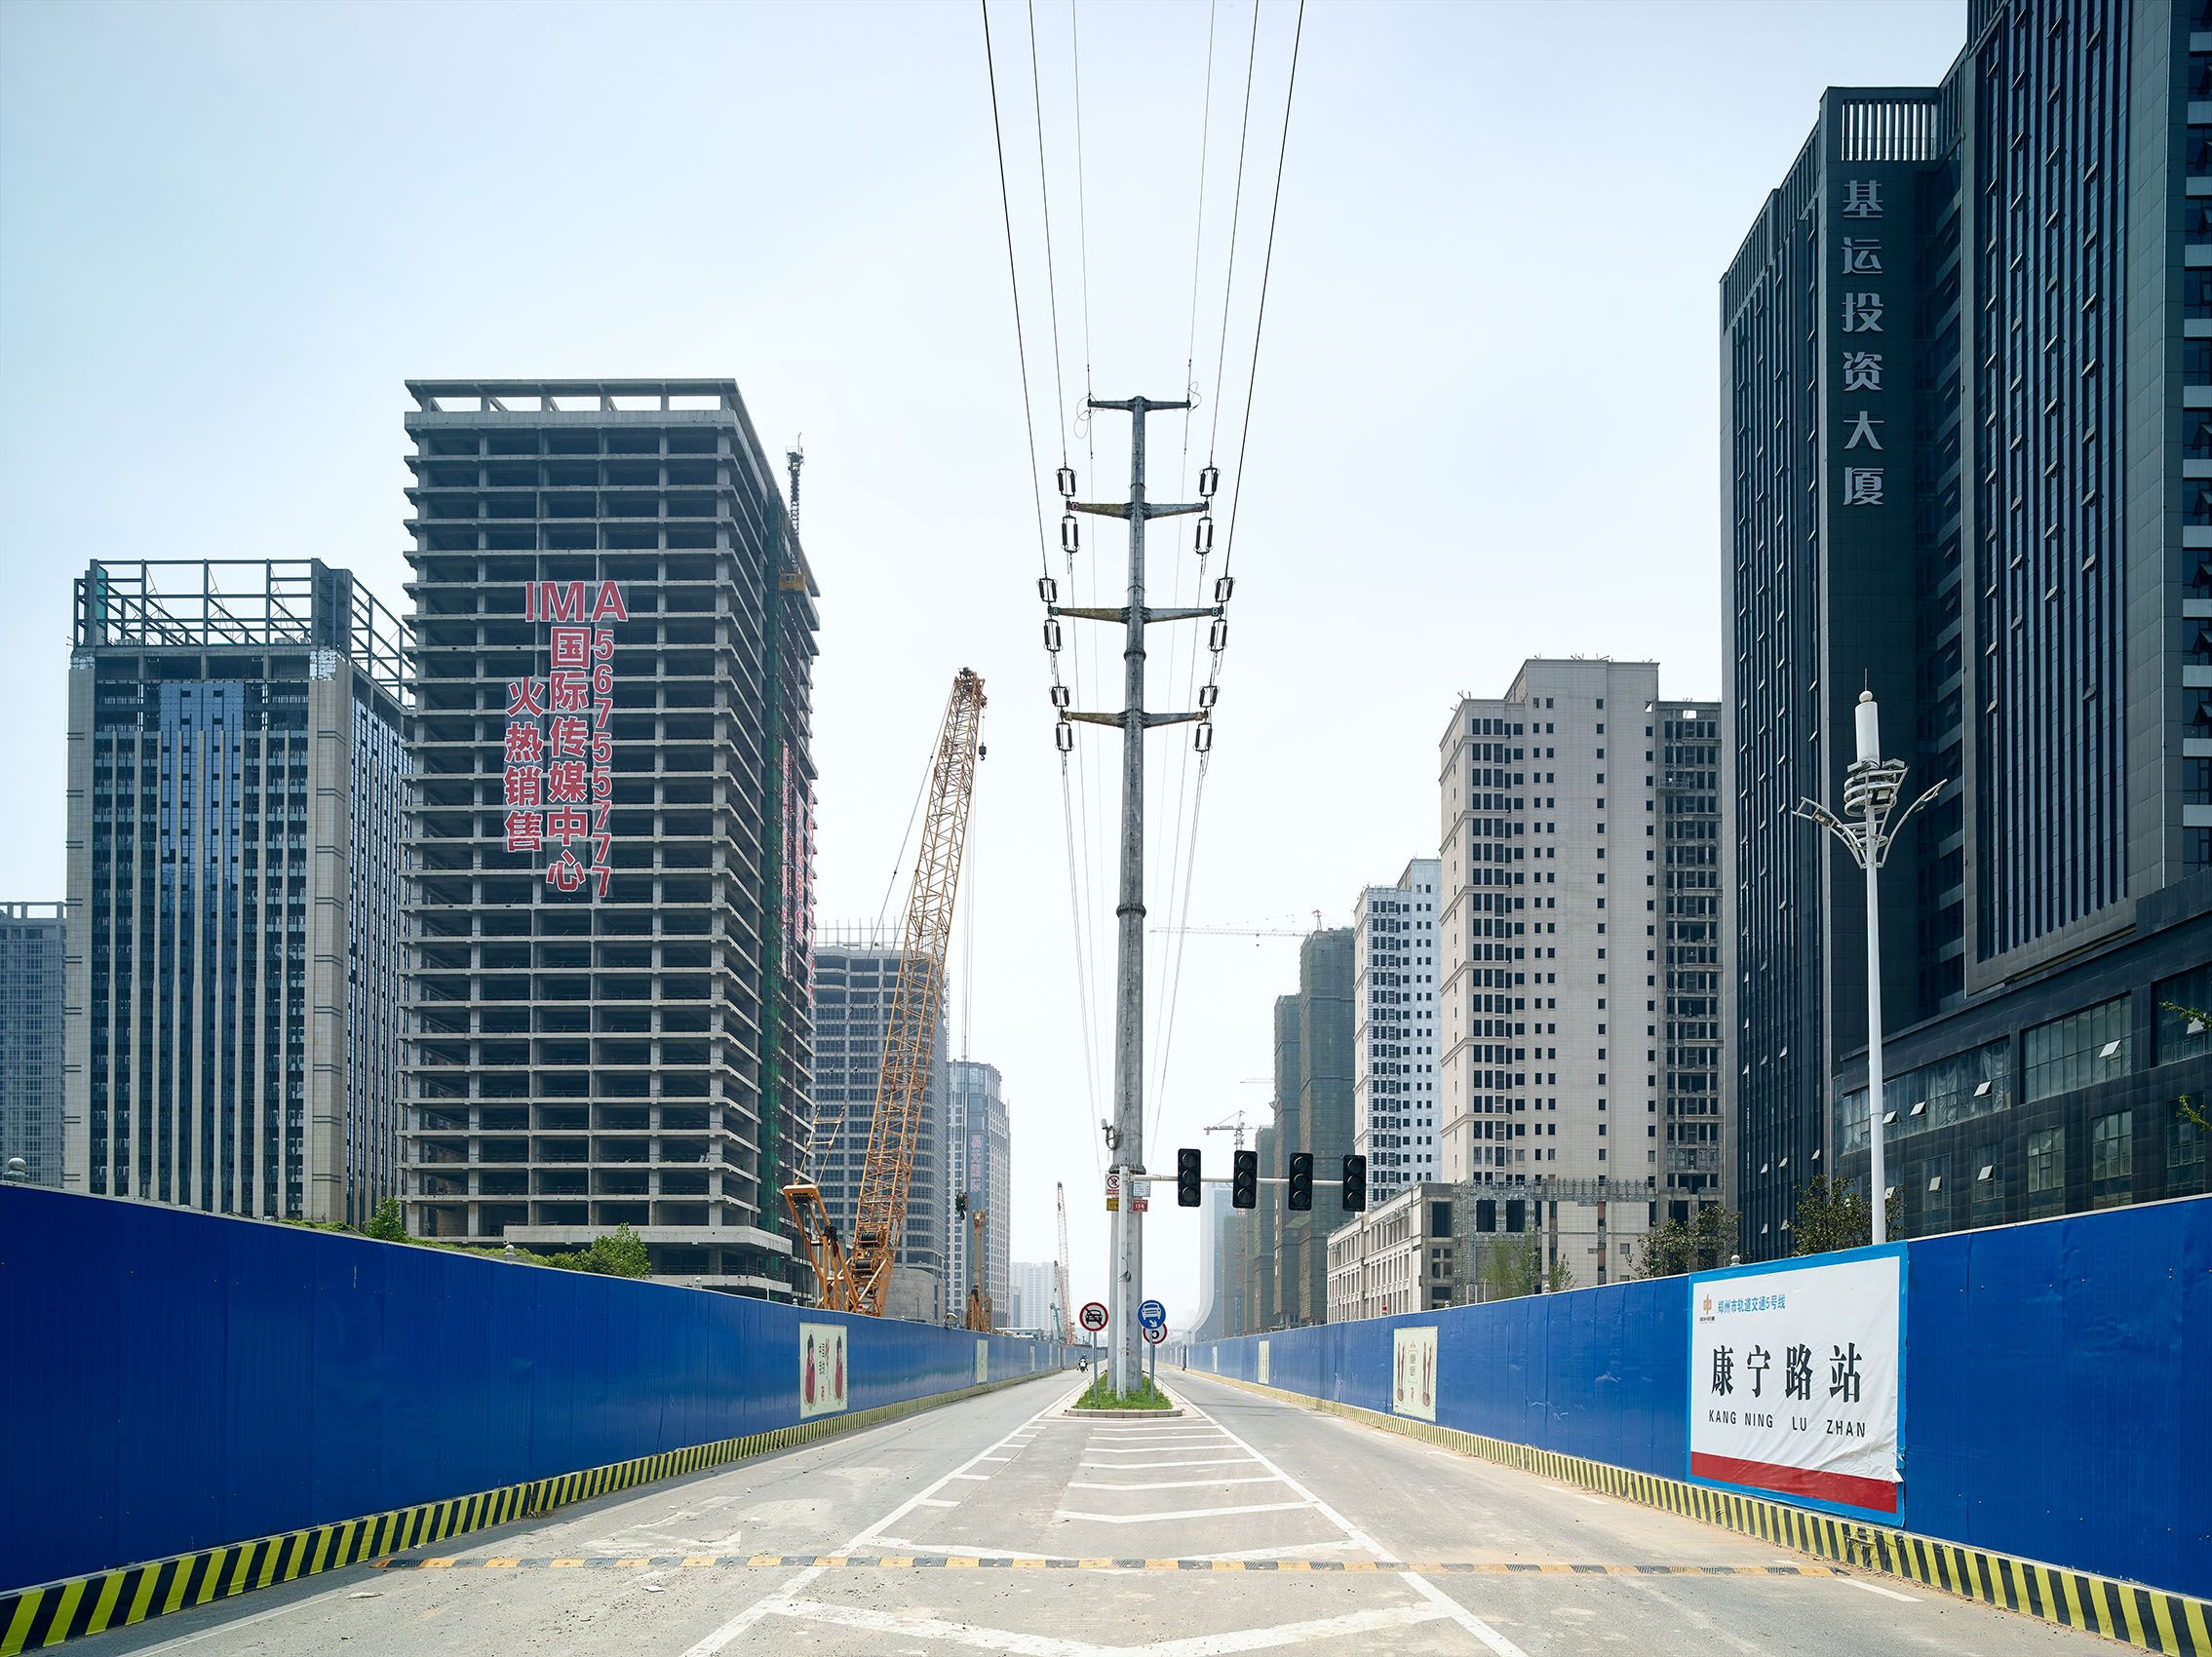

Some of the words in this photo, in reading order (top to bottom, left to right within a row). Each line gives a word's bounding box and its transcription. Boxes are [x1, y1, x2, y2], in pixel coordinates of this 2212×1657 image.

[1841, 179, 1884, 506] 基运投资大厦
[524, 580, 629, 623] IMA
[504, 675, 545, 853] 火热销售
[546, 626, 592, 893] 国际传媒中心
[591, 629, 615, 898] 56755777
[1717, 1293, 1786, 1314] 郑州市轨道交通5号线
[1708, 1409, 1737, 1425] KANG
[1744, 1412, 1773, 1428] NING
[1792, 1416, 1807, 1432] LU
[1826, 1419, 1866, 1438] ZHAN
[1711, 1342, 1862, 1403] 康宁路站
